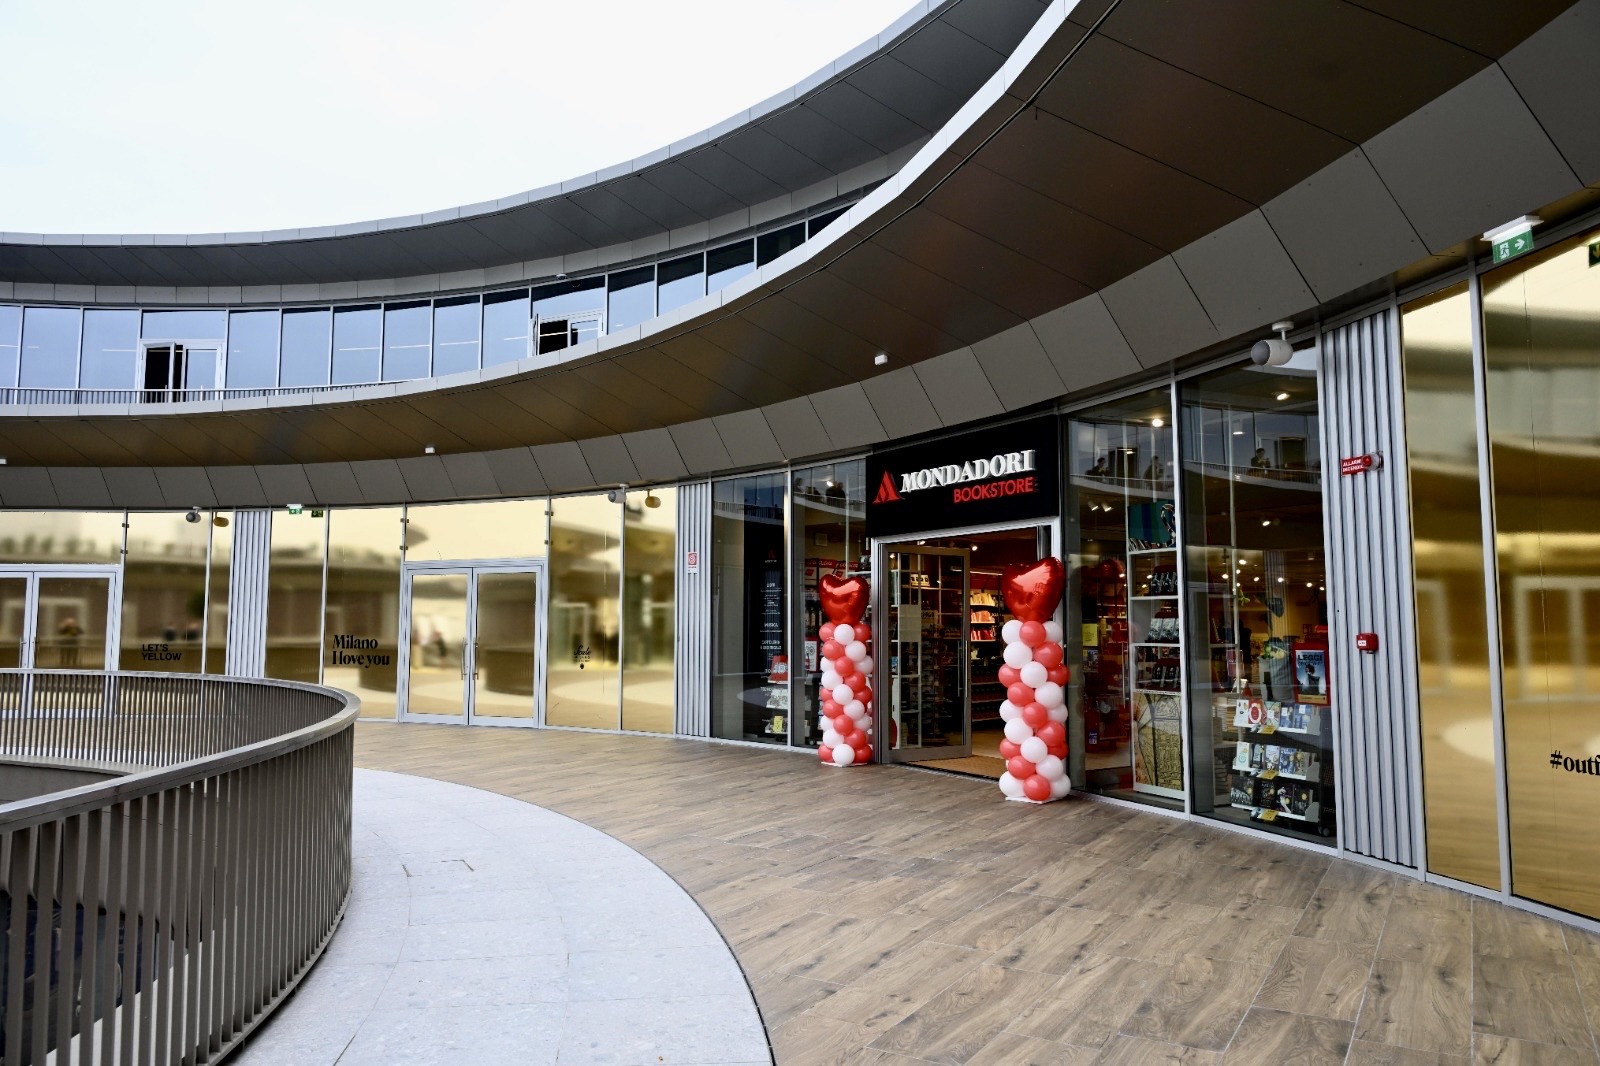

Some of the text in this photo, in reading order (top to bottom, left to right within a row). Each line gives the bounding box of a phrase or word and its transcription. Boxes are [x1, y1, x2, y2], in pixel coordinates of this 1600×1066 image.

[900, 449, 1036, 493] MONDADORI
[1342, 458, 1362, 467] ALLARM
[953, 477, 1035, 503] BOOKSTORE
[142, 643, 169, 652] LET'S
[332, 634, 379, 649] Milano
[141, 652, 182, 661] YELLOW
[332, 650, 390, 669] I love you
[1550, 749, 1600, 776] #outf
